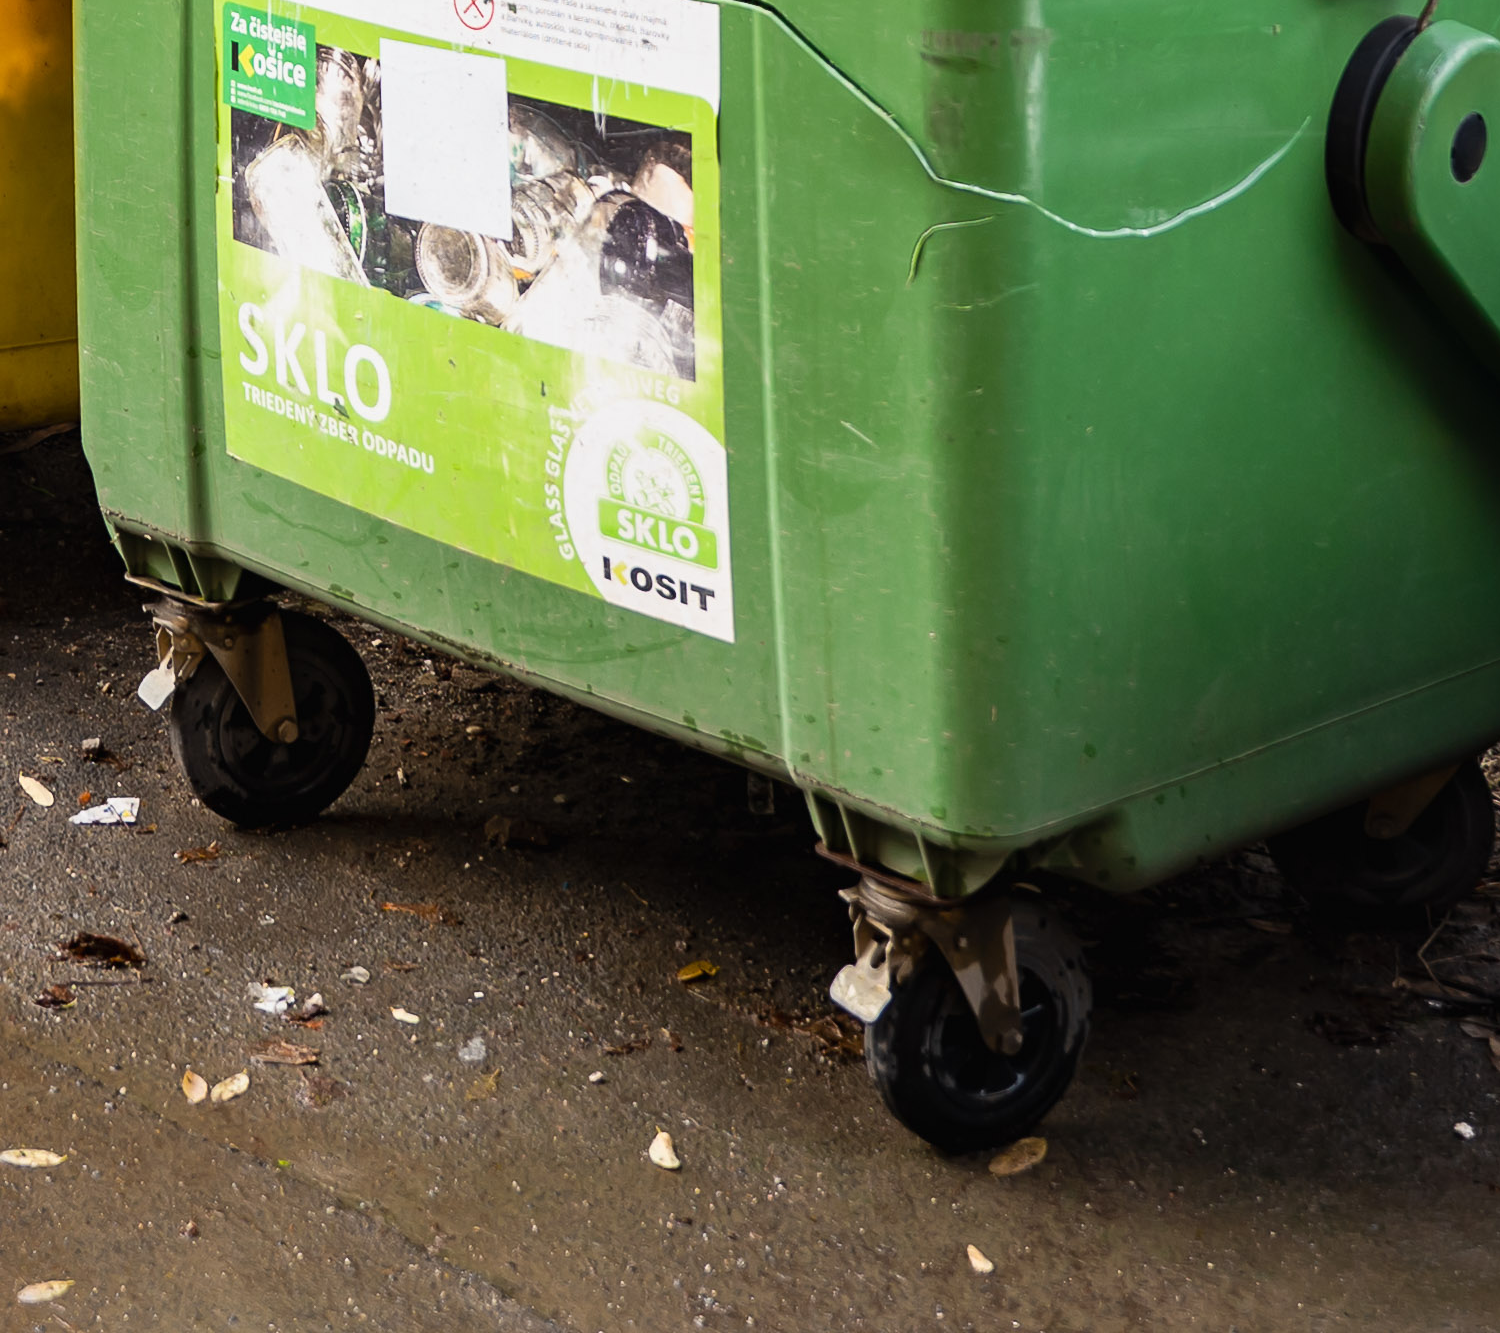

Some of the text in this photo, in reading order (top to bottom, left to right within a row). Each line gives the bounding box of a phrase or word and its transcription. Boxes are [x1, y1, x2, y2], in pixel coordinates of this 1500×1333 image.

[230, 11, 306, 51] Za čistejšie
[231, 40, 306, 88] Košice
[238, 302, 392, 422] SKLO
[242, 381, 435, 475] TRIEDENÝ ZBER ODPADU
[658, 435, 706, 507] TRIEDENÝ
[544, 483, 575, 561] GLASS
[617, 508, 699, 559] SKLO
[602, 556, 715, 611] KOSIT
